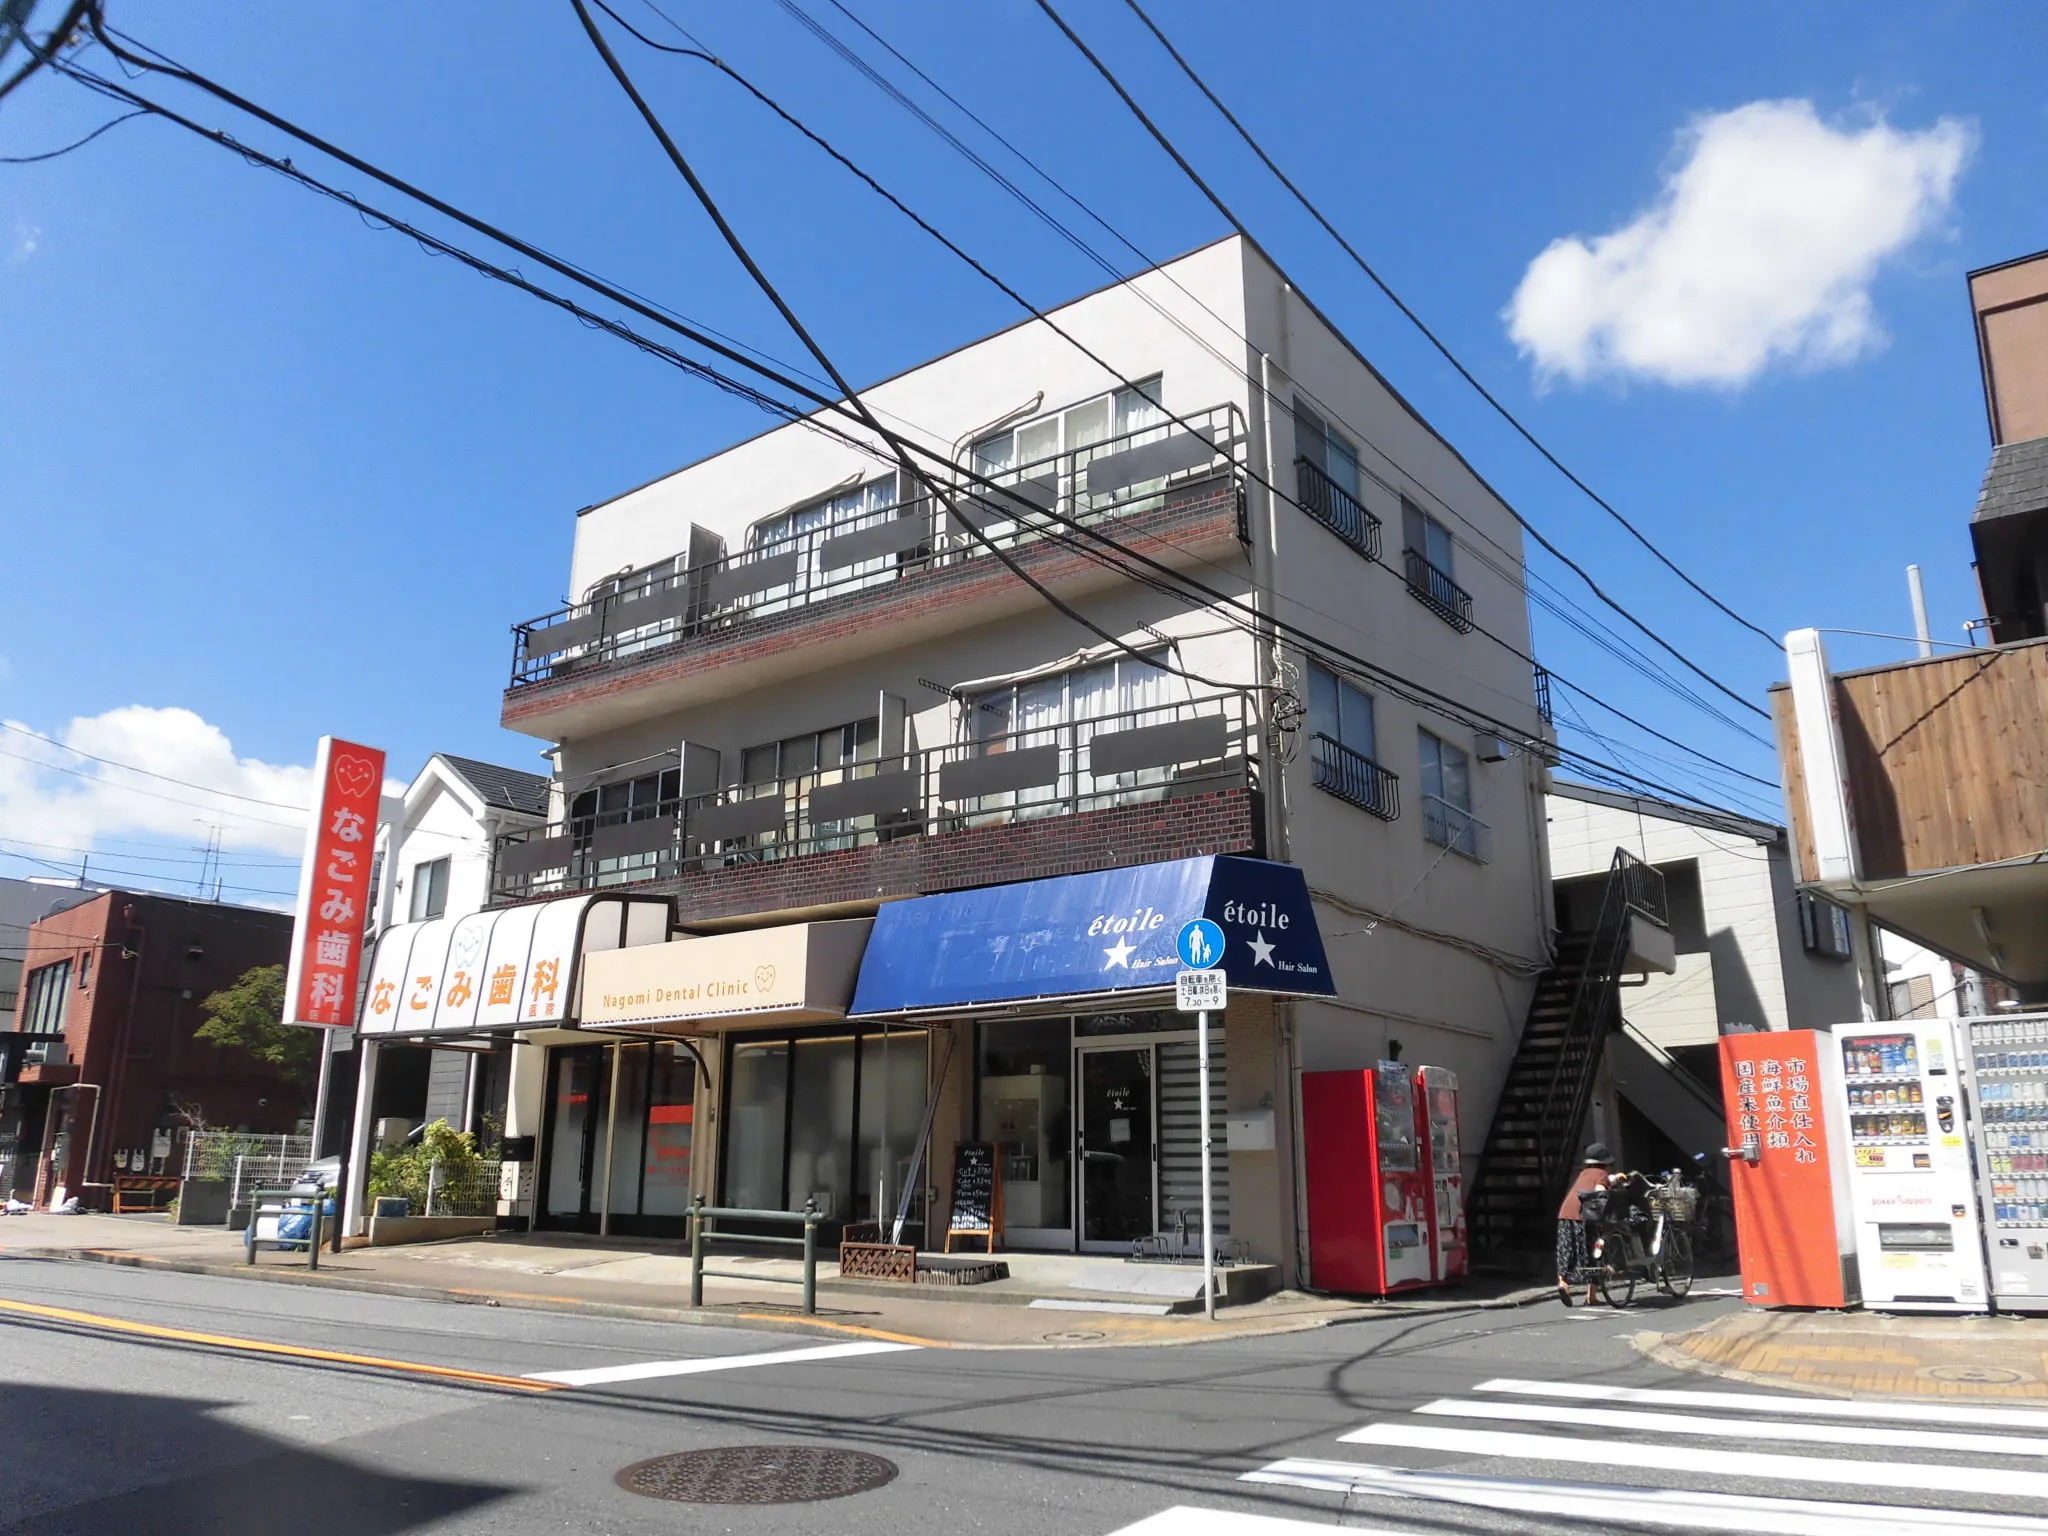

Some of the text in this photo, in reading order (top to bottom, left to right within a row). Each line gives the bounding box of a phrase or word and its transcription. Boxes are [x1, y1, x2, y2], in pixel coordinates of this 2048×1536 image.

[310, 806, 366, 1011] なごみ歯科
[1087, 906, 1165, 937] étoile
[1224, 900, 1290, 930] étoile
[1131, 956, 1179, 969] Hair Salon
[1278, 960, 1318, 974] Hair Salon
[370, 957, 560, 1015] なごみ歯科
[603, 979, 749, 1010] Nagomi Dental Clinic
[1180, 974, 1222, 985] 自転車を除く
[1760, 1059, 1790, 1149] 海鮮魚介類
[1784, 1057, 1817, 1164] 市場直仕入れ
